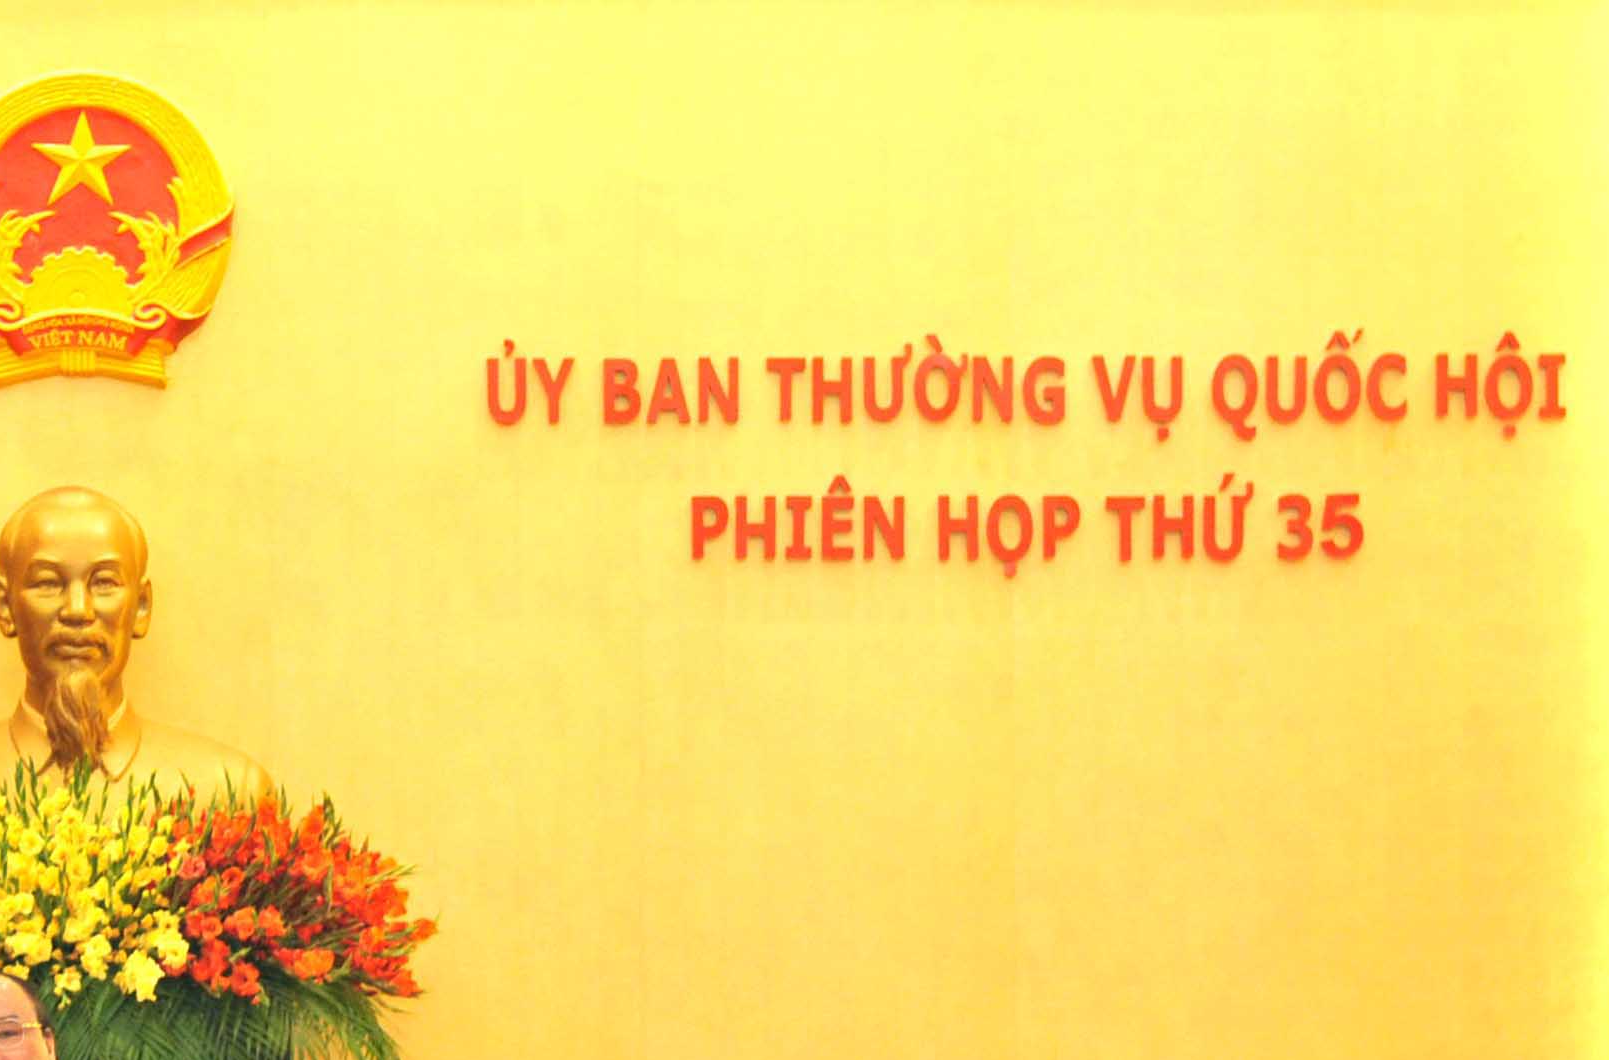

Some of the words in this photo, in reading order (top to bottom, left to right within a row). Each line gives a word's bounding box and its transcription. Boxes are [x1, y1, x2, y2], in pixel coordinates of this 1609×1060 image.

[77, 330, 128, 351] NAM
[486, 339, 574, 427] ỦY
[603, 358, 739, 427] BAN
[766, 335, 1066, 427] THƯỜNG
[1092, 356, 1183, 443] VỤ
[1211, 328, 1408, 443] QUỐC
[1435, 332, 1567, 440] HỘI
[691, 475, 905, 563] PHIÊN
[937, 495, 1081, 579] HỌP
[1105, 473, 1254, 565] THỨ
[1276, 493, 1365, 564] 35
